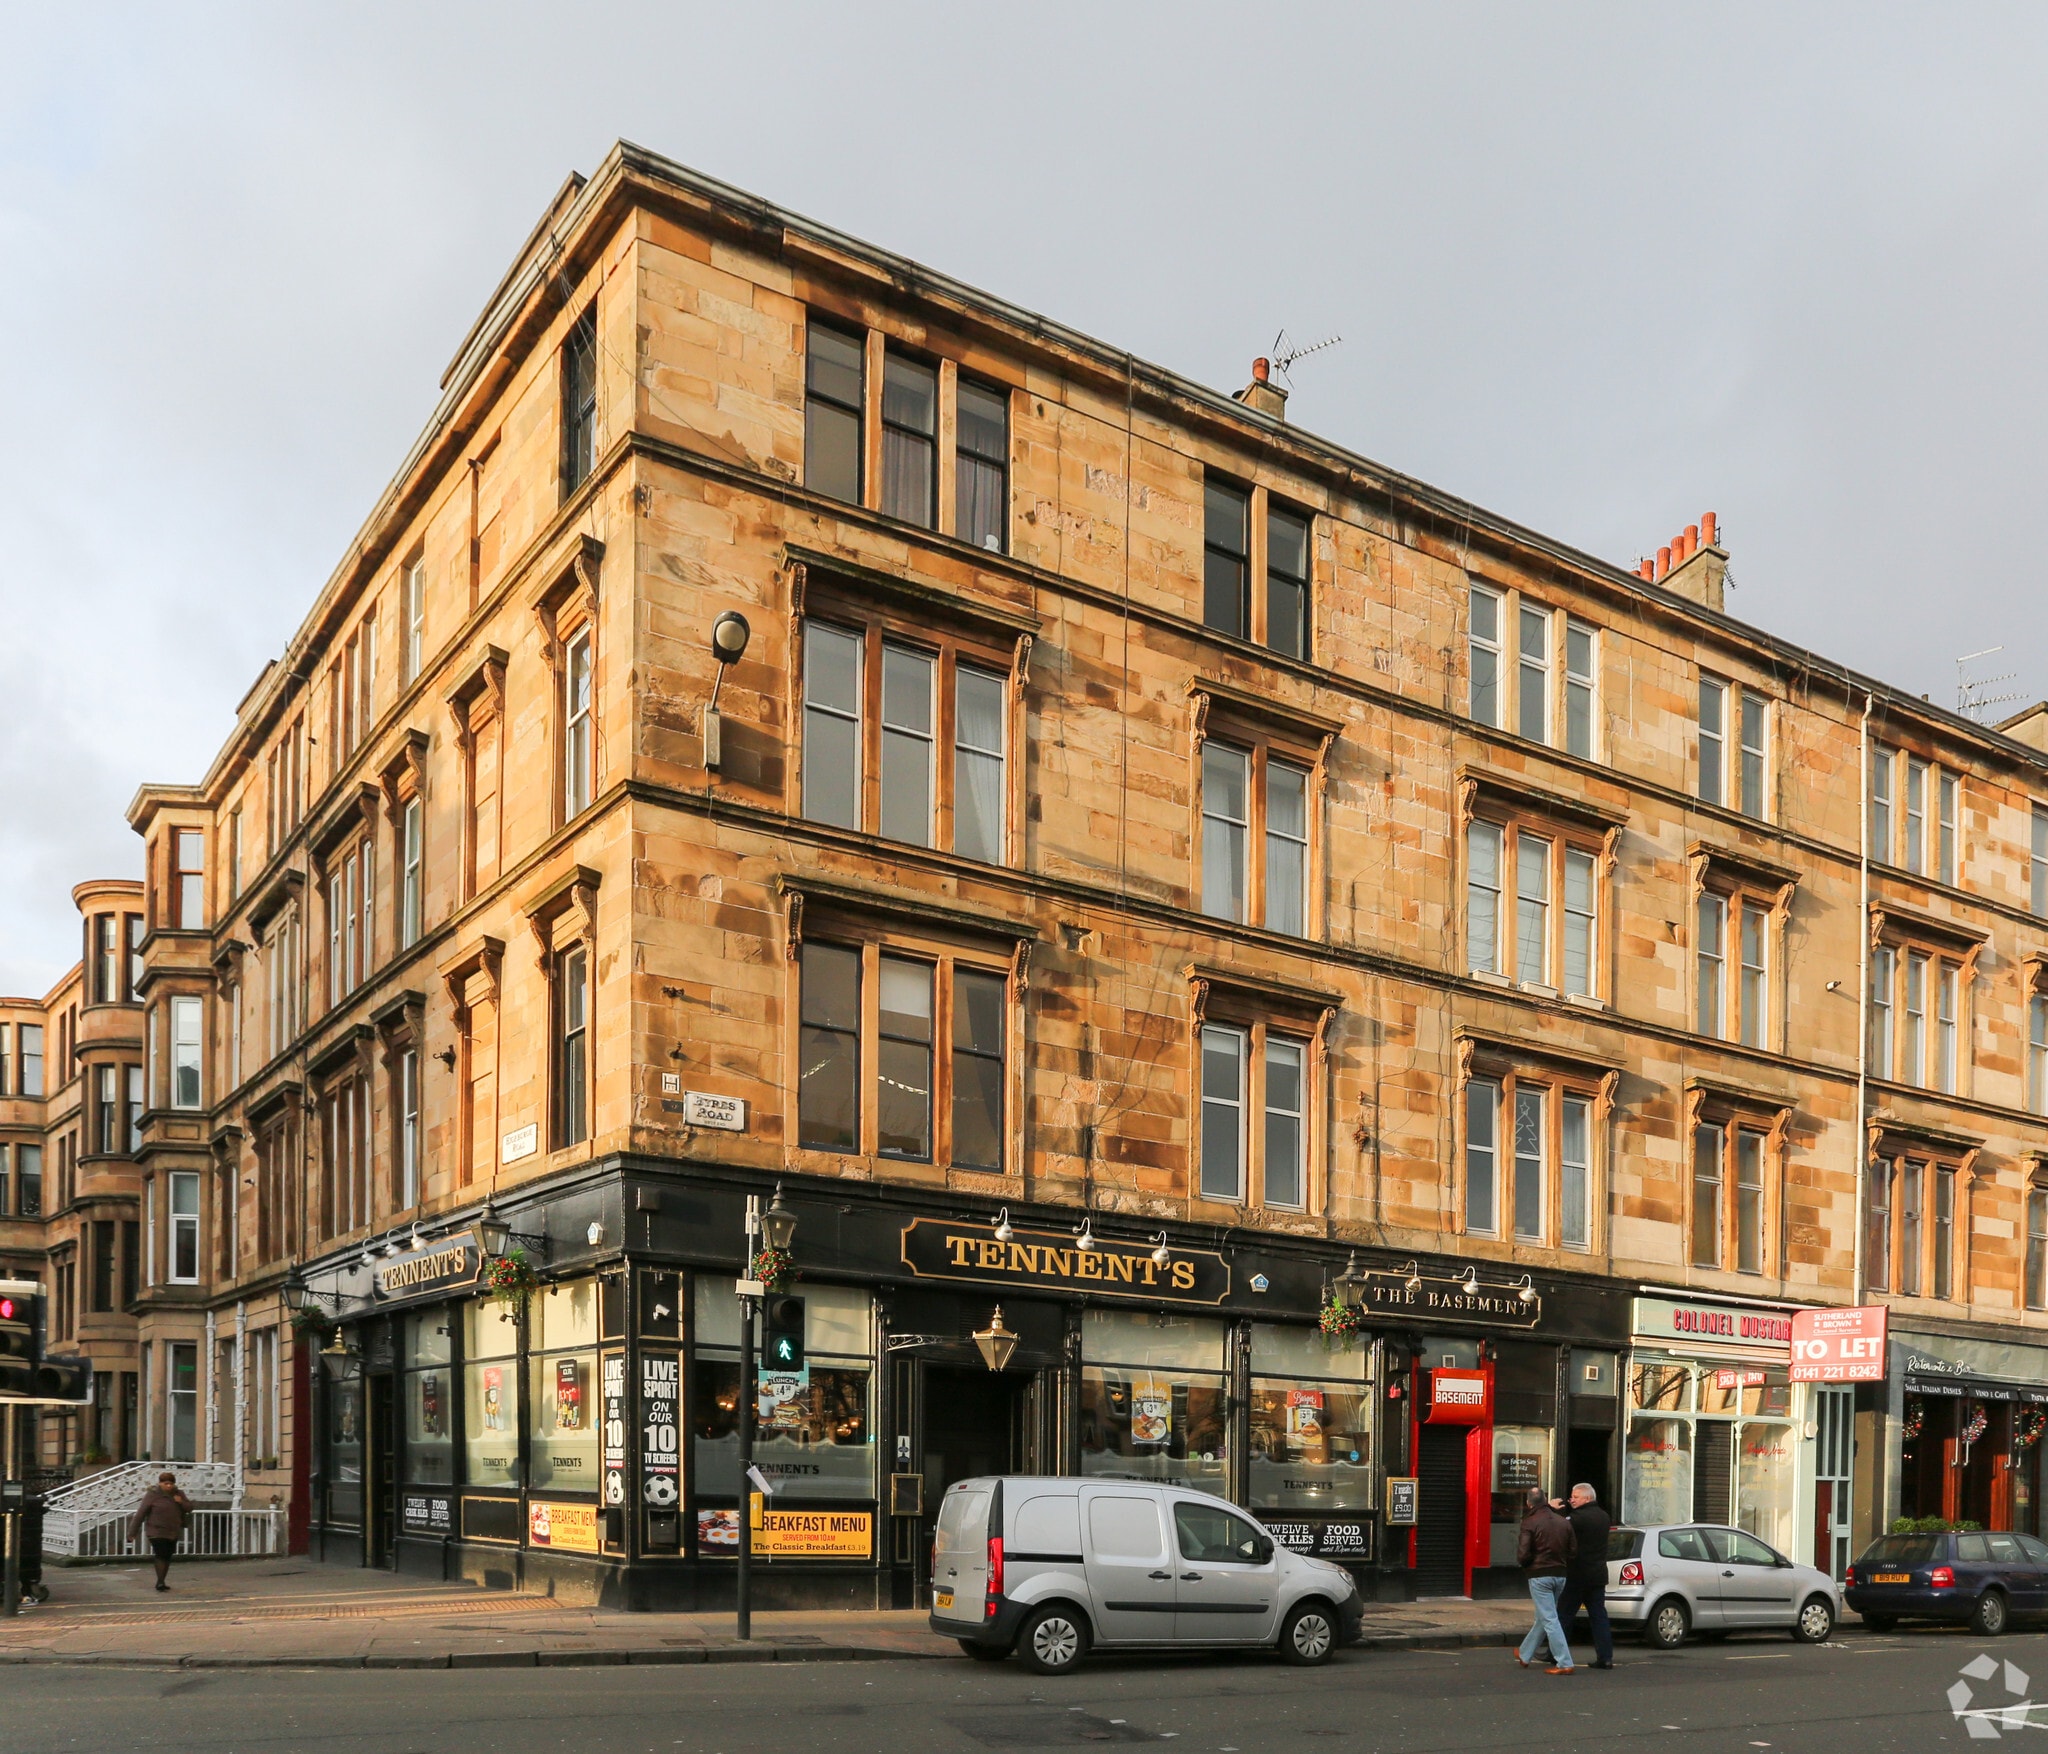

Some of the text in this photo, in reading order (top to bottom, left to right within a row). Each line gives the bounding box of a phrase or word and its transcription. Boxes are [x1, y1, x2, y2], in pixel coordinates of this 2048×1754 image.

[696, 1108, 734, 1121] ROAD
[382, 1246, 466, 1291] TENNENT'S
[946, 1235, 1195, 1289] TENNENT'S
[1374, 1287, 1531, 1316] THE BASEMENT
[1814, 1312, 1862, 1321] SUTHERLAND
[1674, 1309, 1791, 1341] COLONEL MUSTAR
[1823, 1320, 1852, 1329] BROWN
[1794, 1337, 1881, 1360] TO LET
[605, 1359, 624, 1380] LIVE
[644, 1360, 678, 1381] LIVE
[1794, 1365, 1878, 1379] 0141 221 8242
[1907, 1355, 1945, 1372] Ristorante
[1954, 1359, 1974, 1376] Bar
[644, 1380, 678, 1399] SPORT
[1435, 1391, 1484, 1405] BASEMENT
[652, 1401, 670, 1412] ON
[648, 1412, 673, 1423] OUR
[605, 1419, 623, 1448] 10
[644, 1424, 677, 1452] 10
[644, 1452, 677, 1464] TV SCREENS
[432, 1500, 448, 1510] FOOD
[761, 1515, 866, 1532] REAKFAST MENU
[1263, 1524, 1309, 1534] TWELVE
[1327, 1525, 1360, 1535] FOOD
[782, 1533, 804, 1541] SERVED
[1288, 1535, 1314, 1544] ALES
[1323, 1535, 1363, 1545] SERVED
[753, 1542, 771, 1550] The
[772, 1543, 804, 1551] Classic
[806, 1543, 846, 1551] Breakfast
